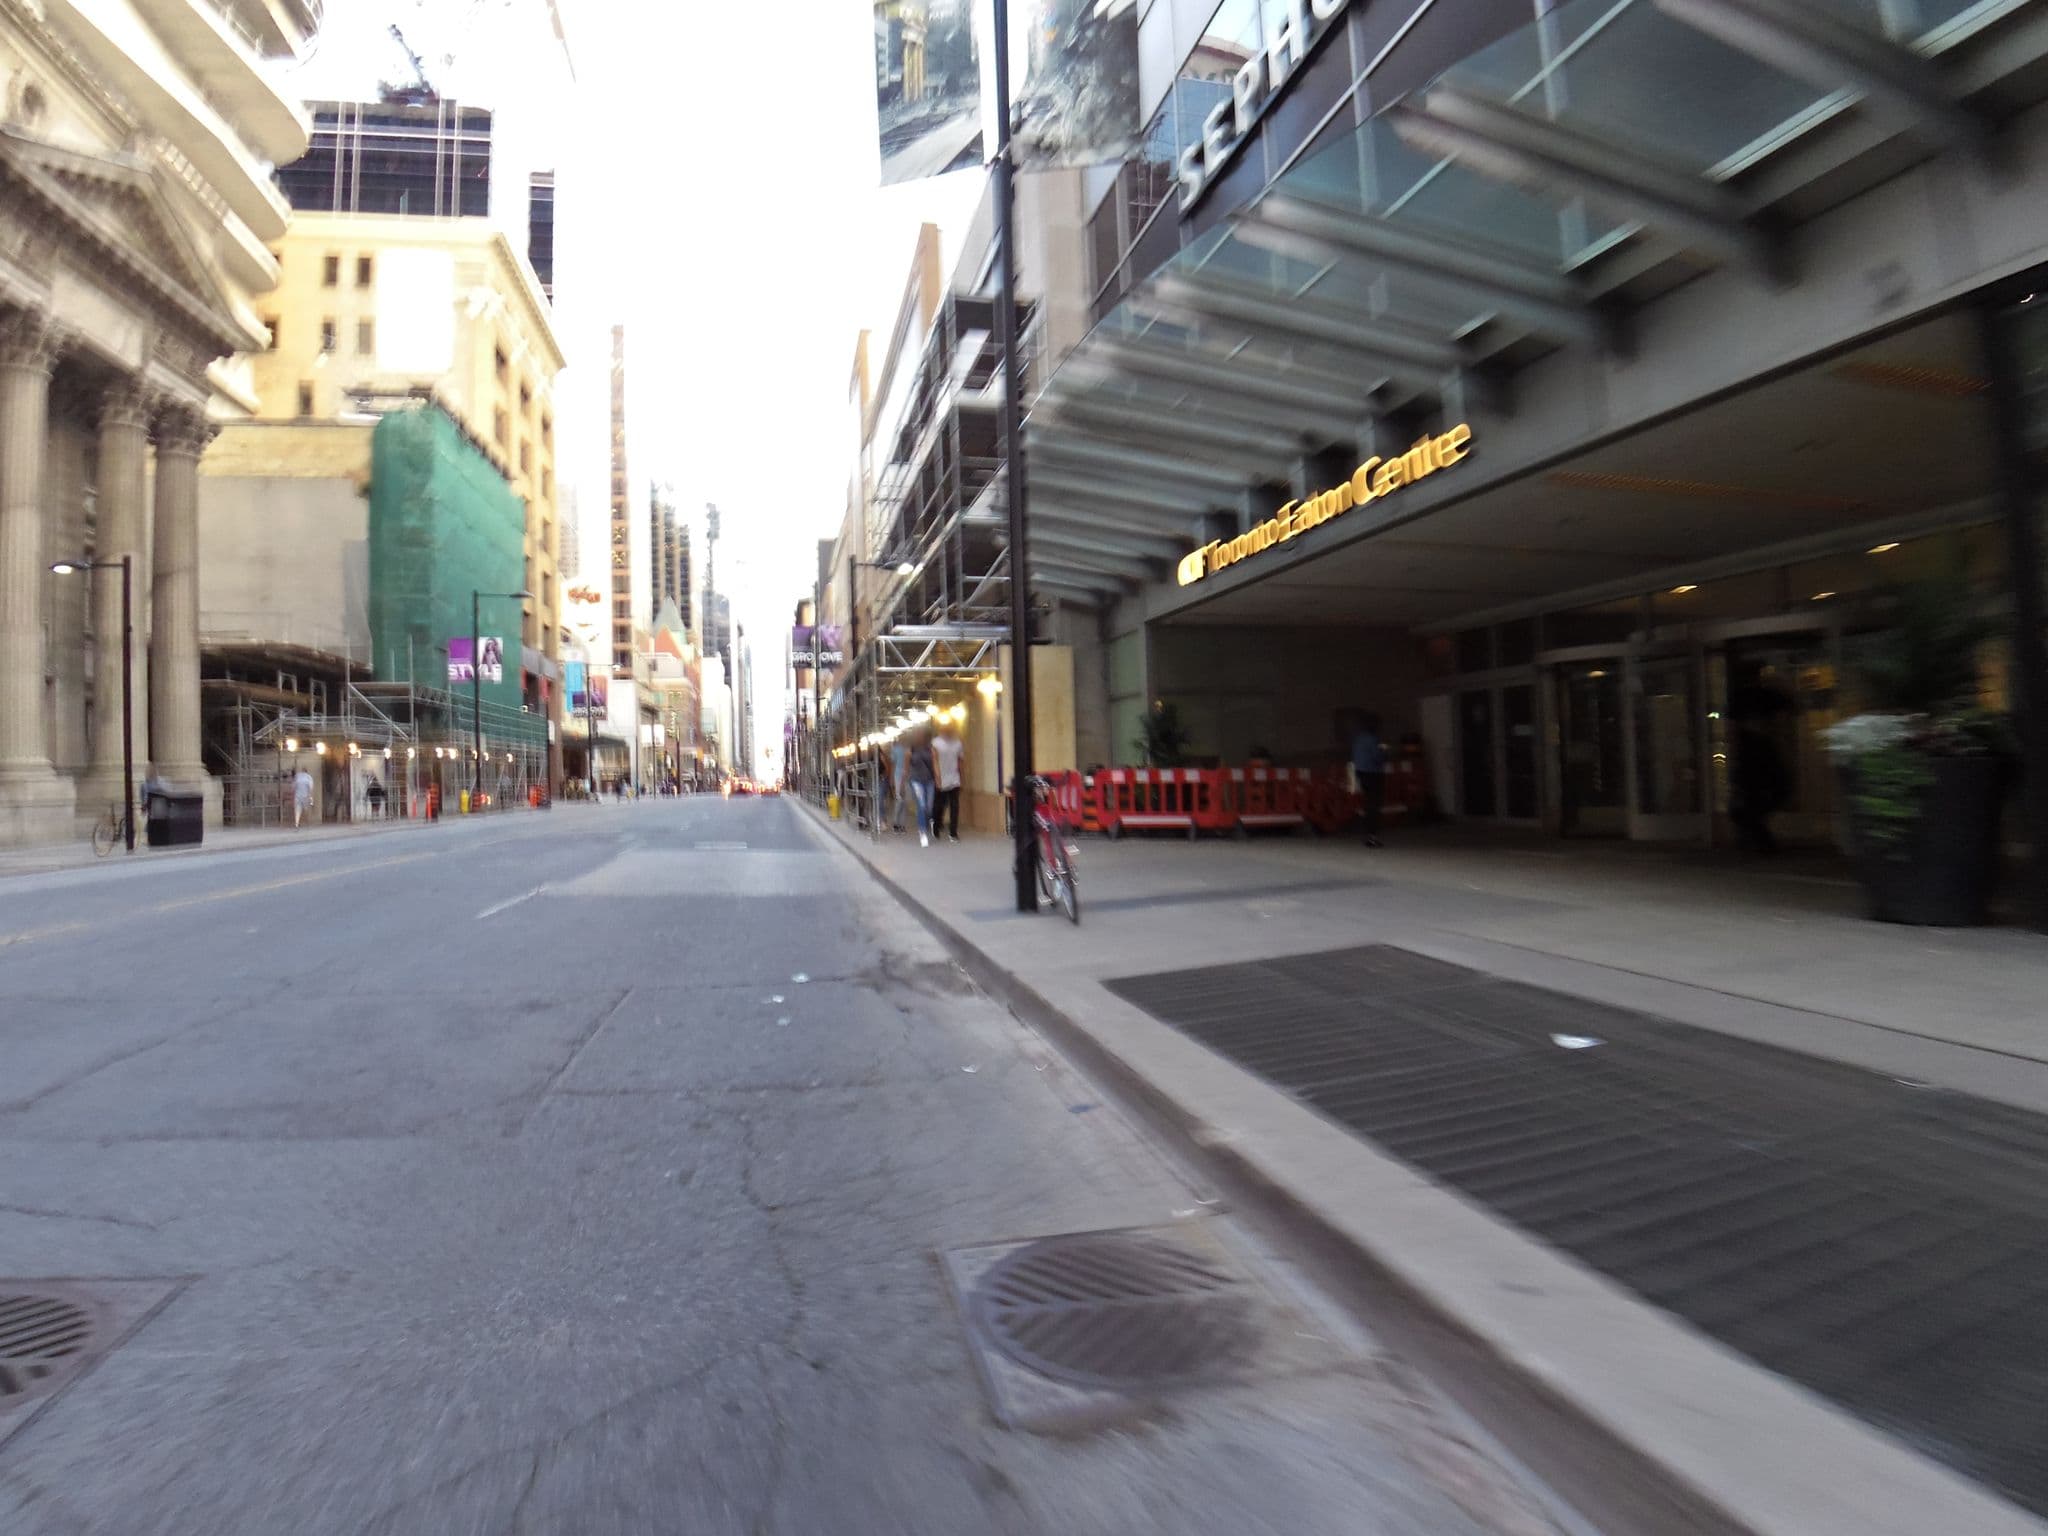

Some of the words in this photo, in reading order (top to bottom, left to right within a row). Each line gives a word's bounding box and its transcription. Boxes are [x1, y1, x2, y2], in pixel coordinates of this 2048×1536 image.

[1207, 518, 1279, 574] Toronto
[1278, 481, 1353, 542] Eaton
[1352, 423, 1471, 505] Centre
